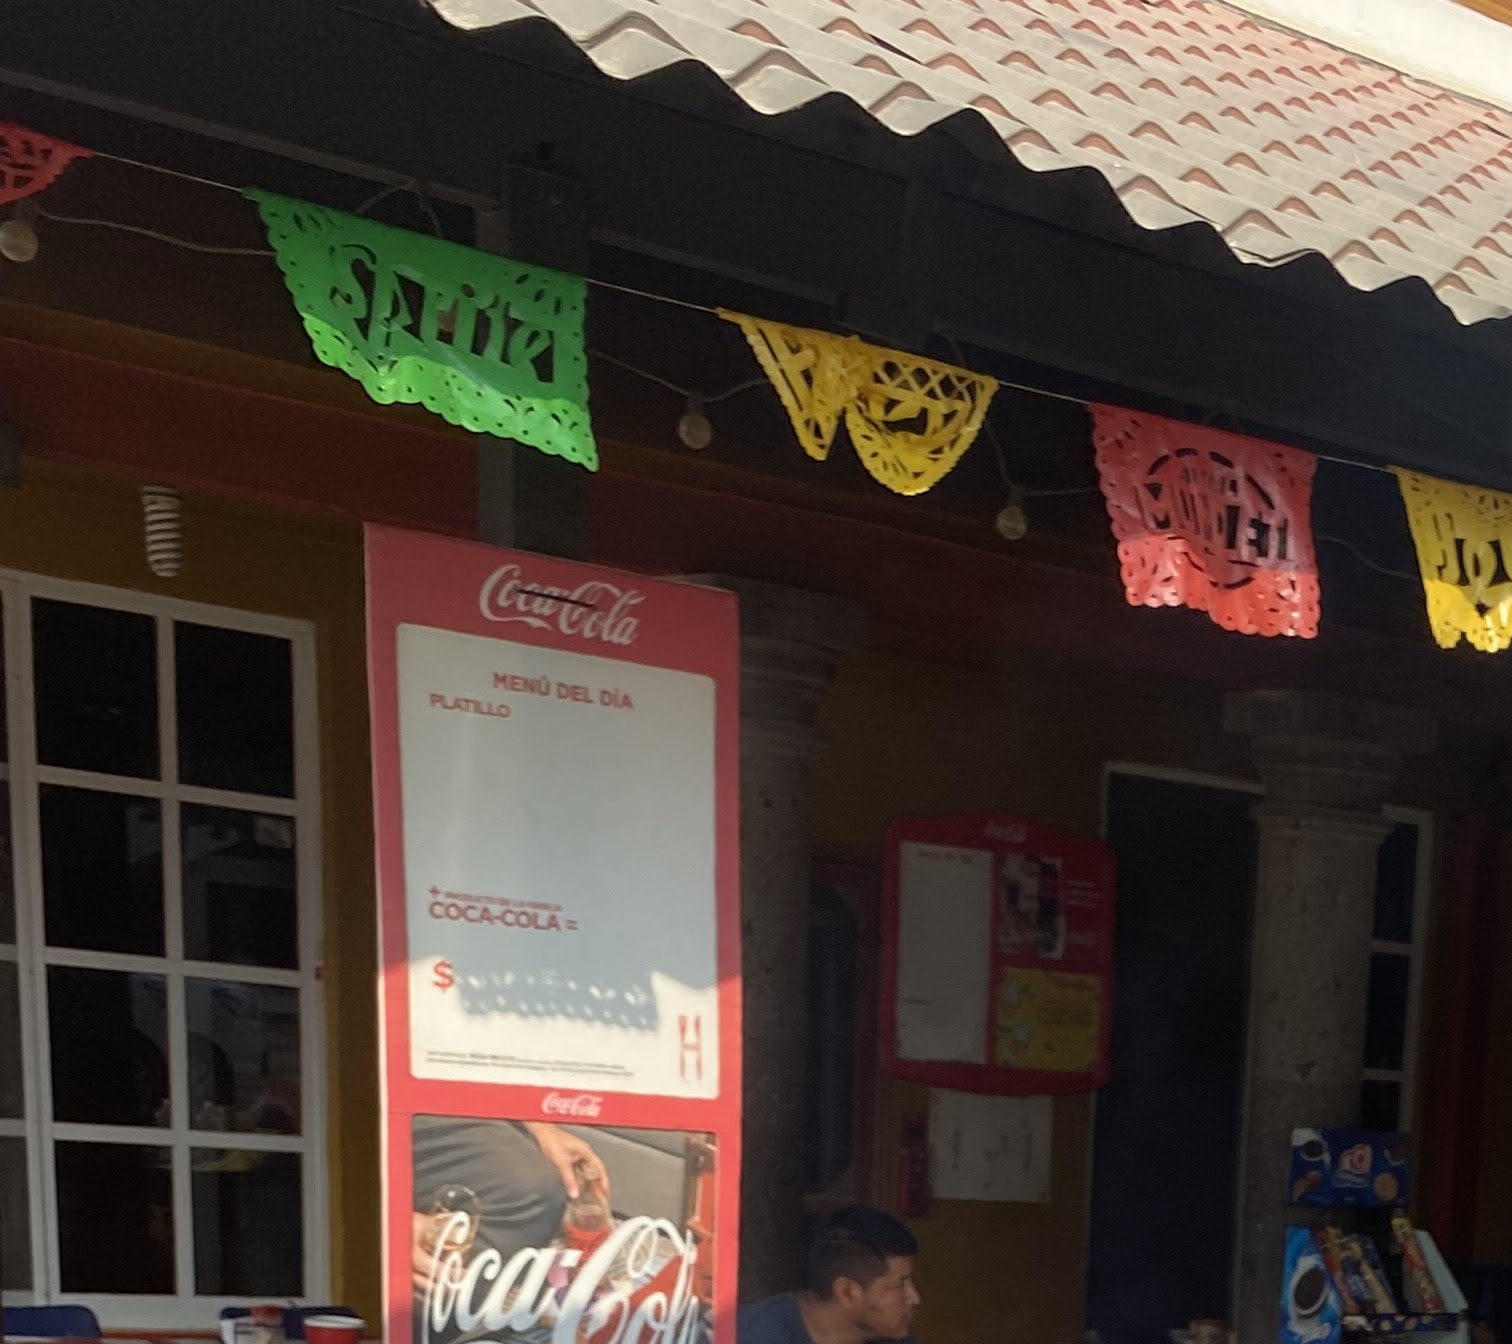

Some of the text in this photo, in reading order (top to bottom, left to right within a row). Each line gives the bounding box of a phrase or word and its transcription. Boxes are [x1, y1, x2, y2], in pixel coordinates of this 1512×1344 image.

[478, 563, 647, 646] Coca-Cola
[429, 693, 512, 719] PLATILLO
[493, 671, 634, 709] MENÚ DEL DÍA
[428, 901, 561, 933] COCA-COLA
[432, 959, 455, 992] $
[541, 1091, 605, 1119] Coca-Cola
